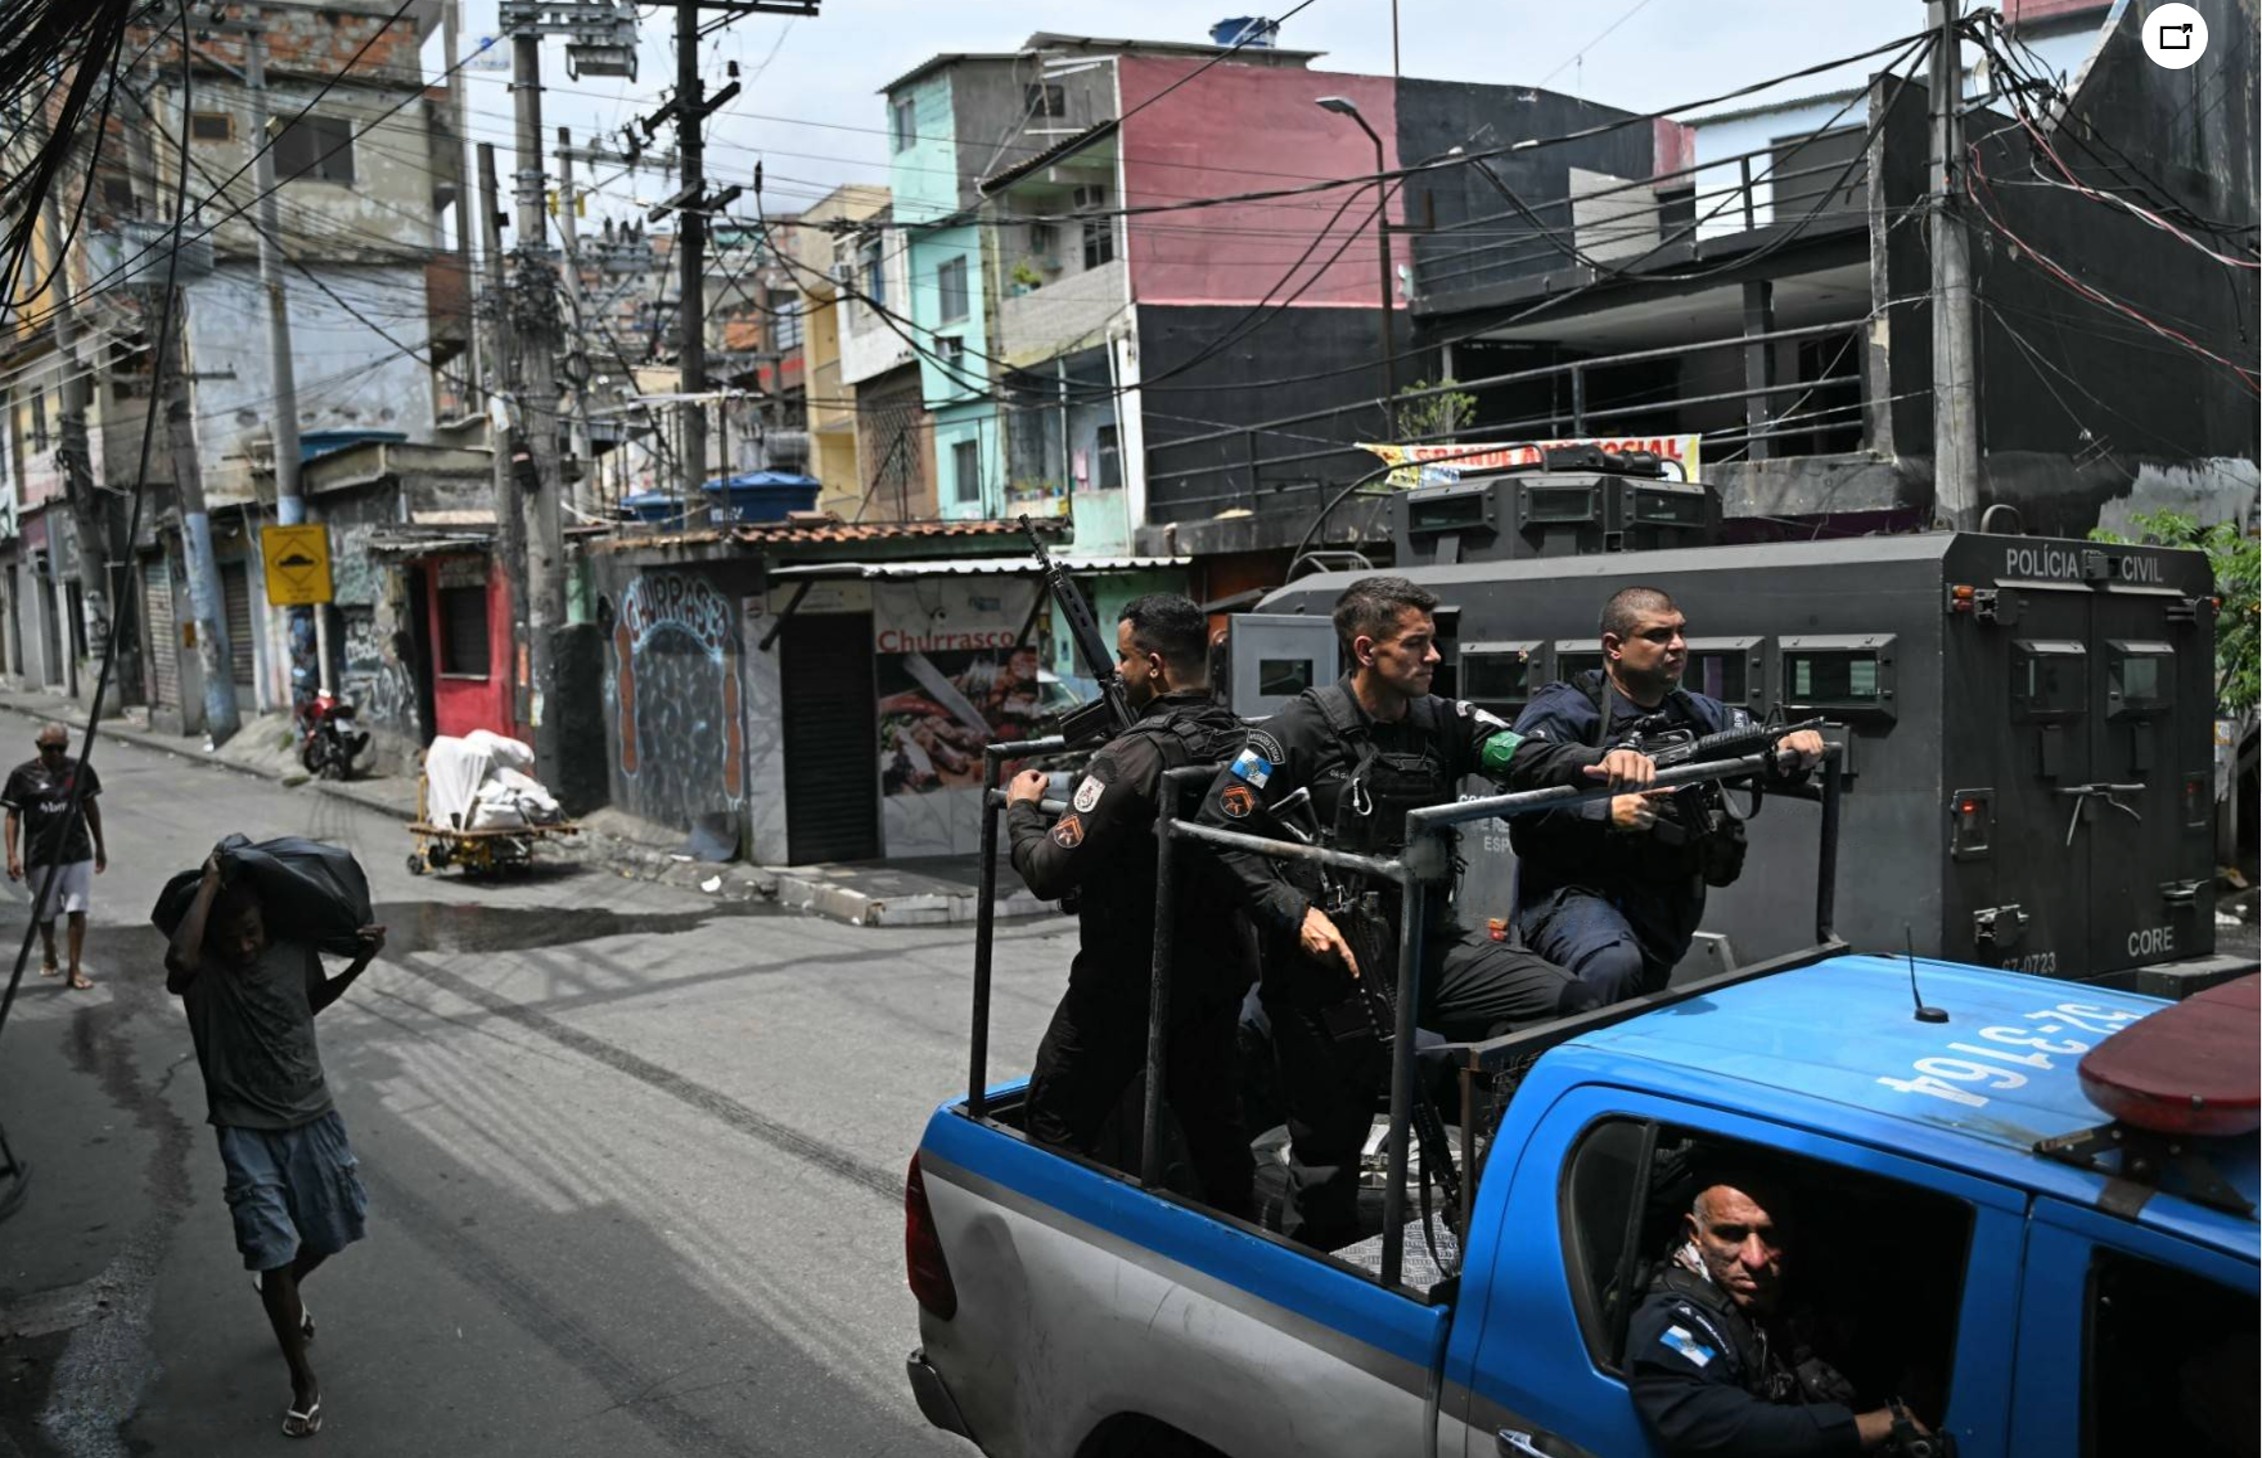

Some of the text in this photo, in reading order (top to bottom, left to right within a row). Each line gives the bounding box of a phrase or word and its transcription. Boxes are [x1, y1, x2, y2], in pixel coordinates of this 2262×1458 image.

[2006, 544, 2164, 583] POLÍCIA CIVIL
[877, 630, 1016, 653] Churrasco
[1484, 836, 1513, 853] ESP
[2127, 925, 2175, 958] CORE
[1876, 1003, 2143, 1108] 52-3164
